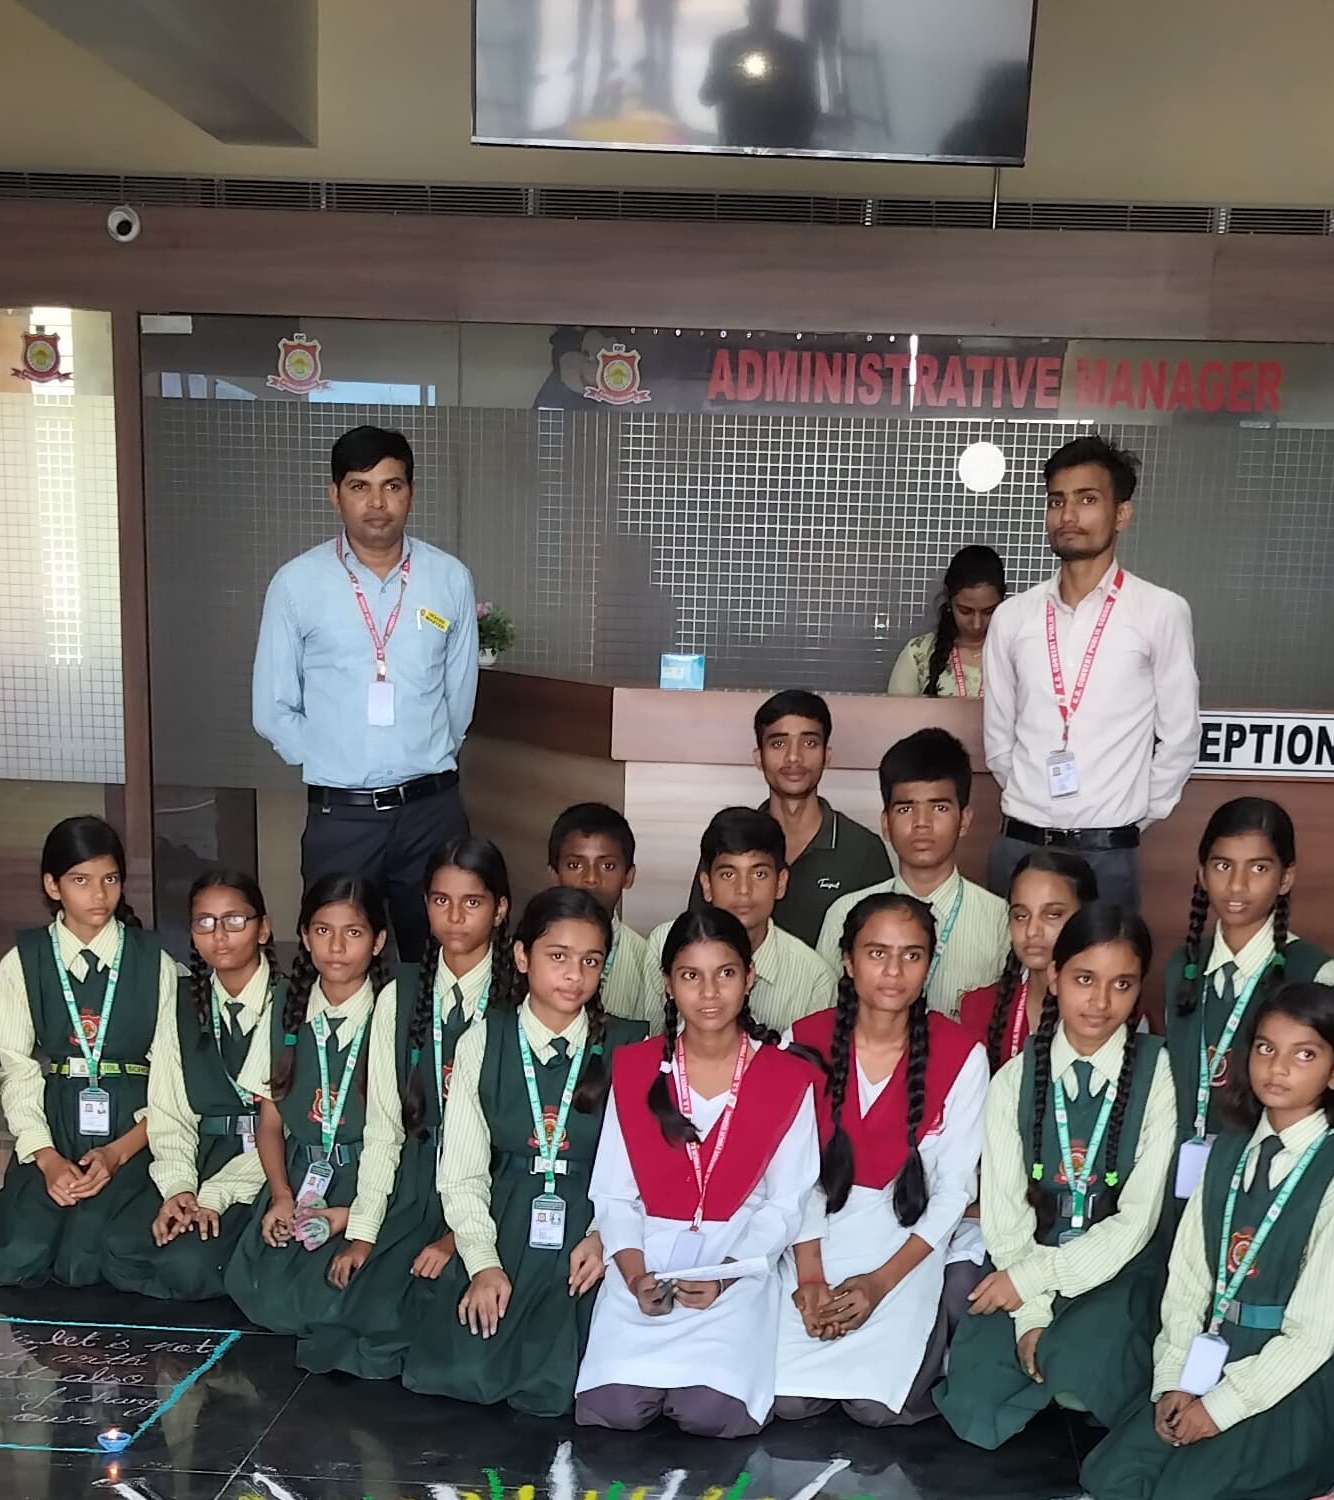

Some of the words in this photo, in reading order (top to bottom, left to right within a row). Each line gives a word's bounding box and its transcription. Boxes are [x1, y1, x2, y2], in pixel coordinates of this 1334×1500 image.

[707, 348, 1061, 410] ADMINISTRATIVE
[1074, 357, 1284, 414] MANAGER
[47, 1328, 99, 1349] let
[105, 1333, 131, 1350] is
[61, 1365, 147, 1385] also
